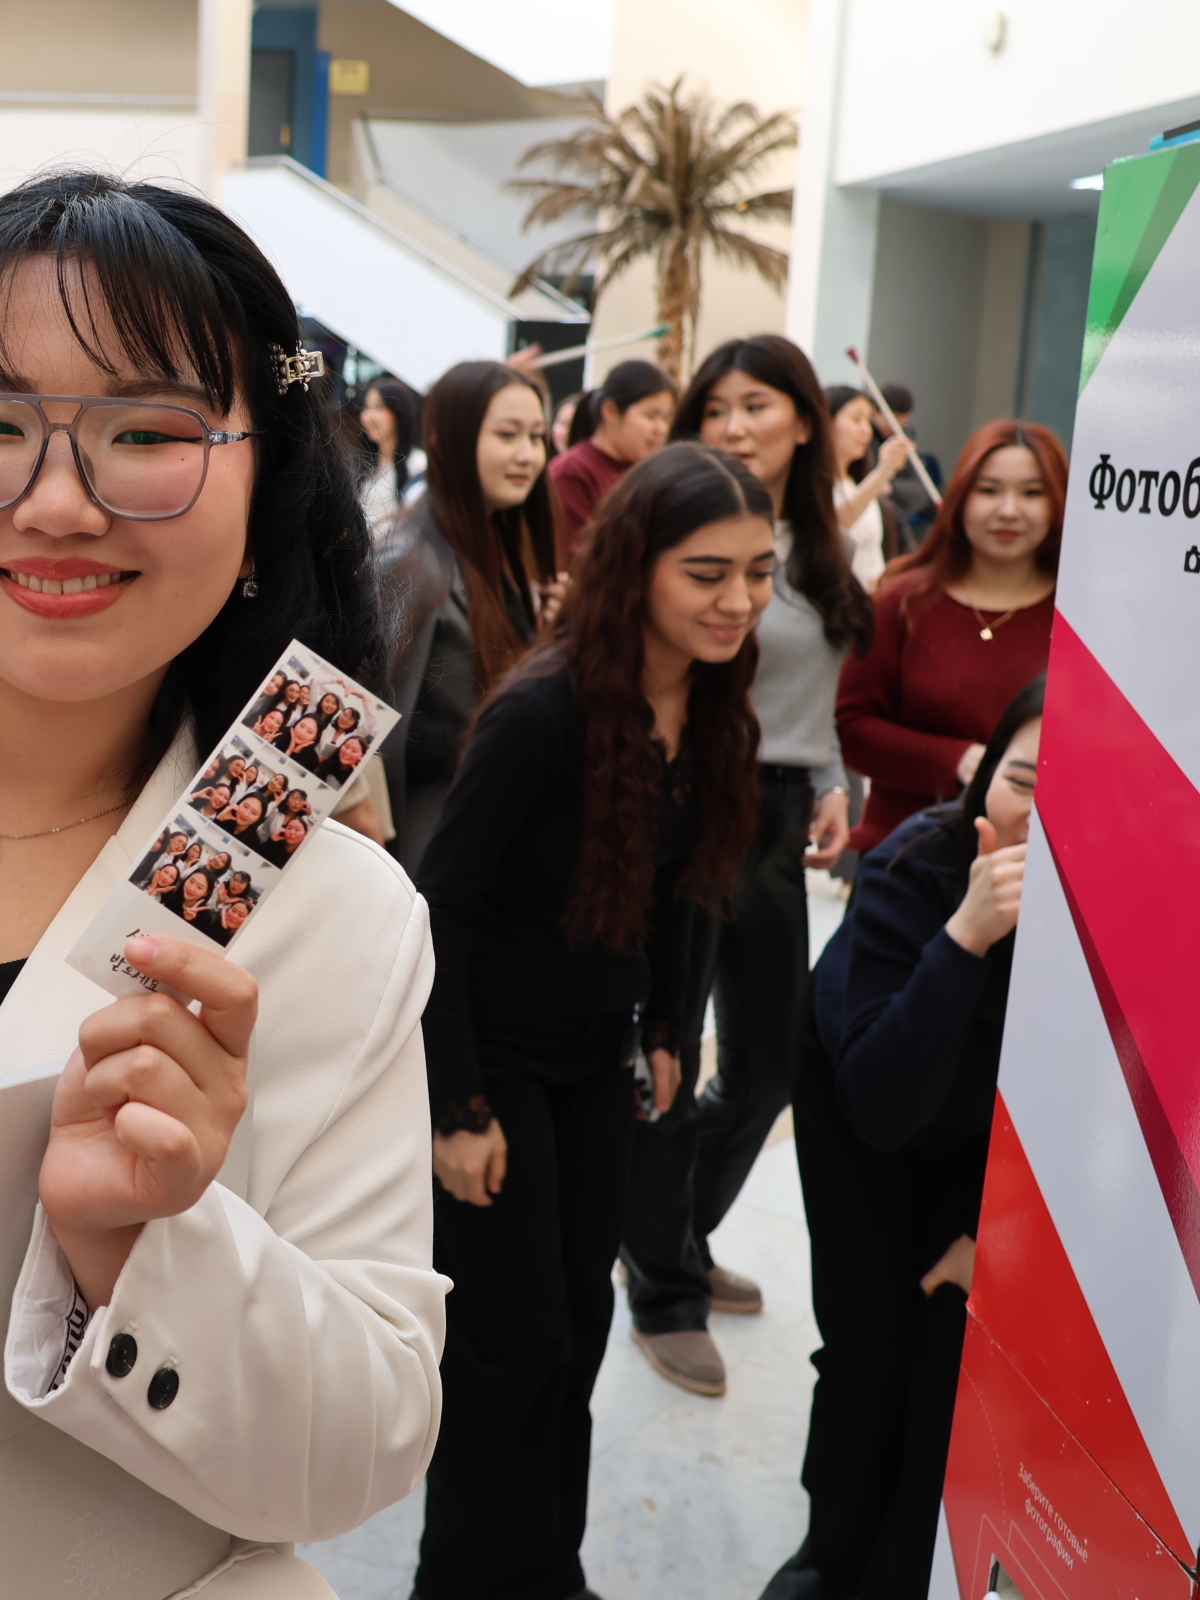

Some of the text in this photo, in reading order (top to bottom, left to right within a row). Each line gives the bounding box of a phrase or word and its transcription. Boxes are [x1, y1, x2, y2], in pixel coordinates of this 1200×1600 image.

[109, 953, 160, 993] 받으세요
[1018, 1461, 1088, 1564] Заберите готовые
[1025, 1498, 1075, 1571] фотографии
